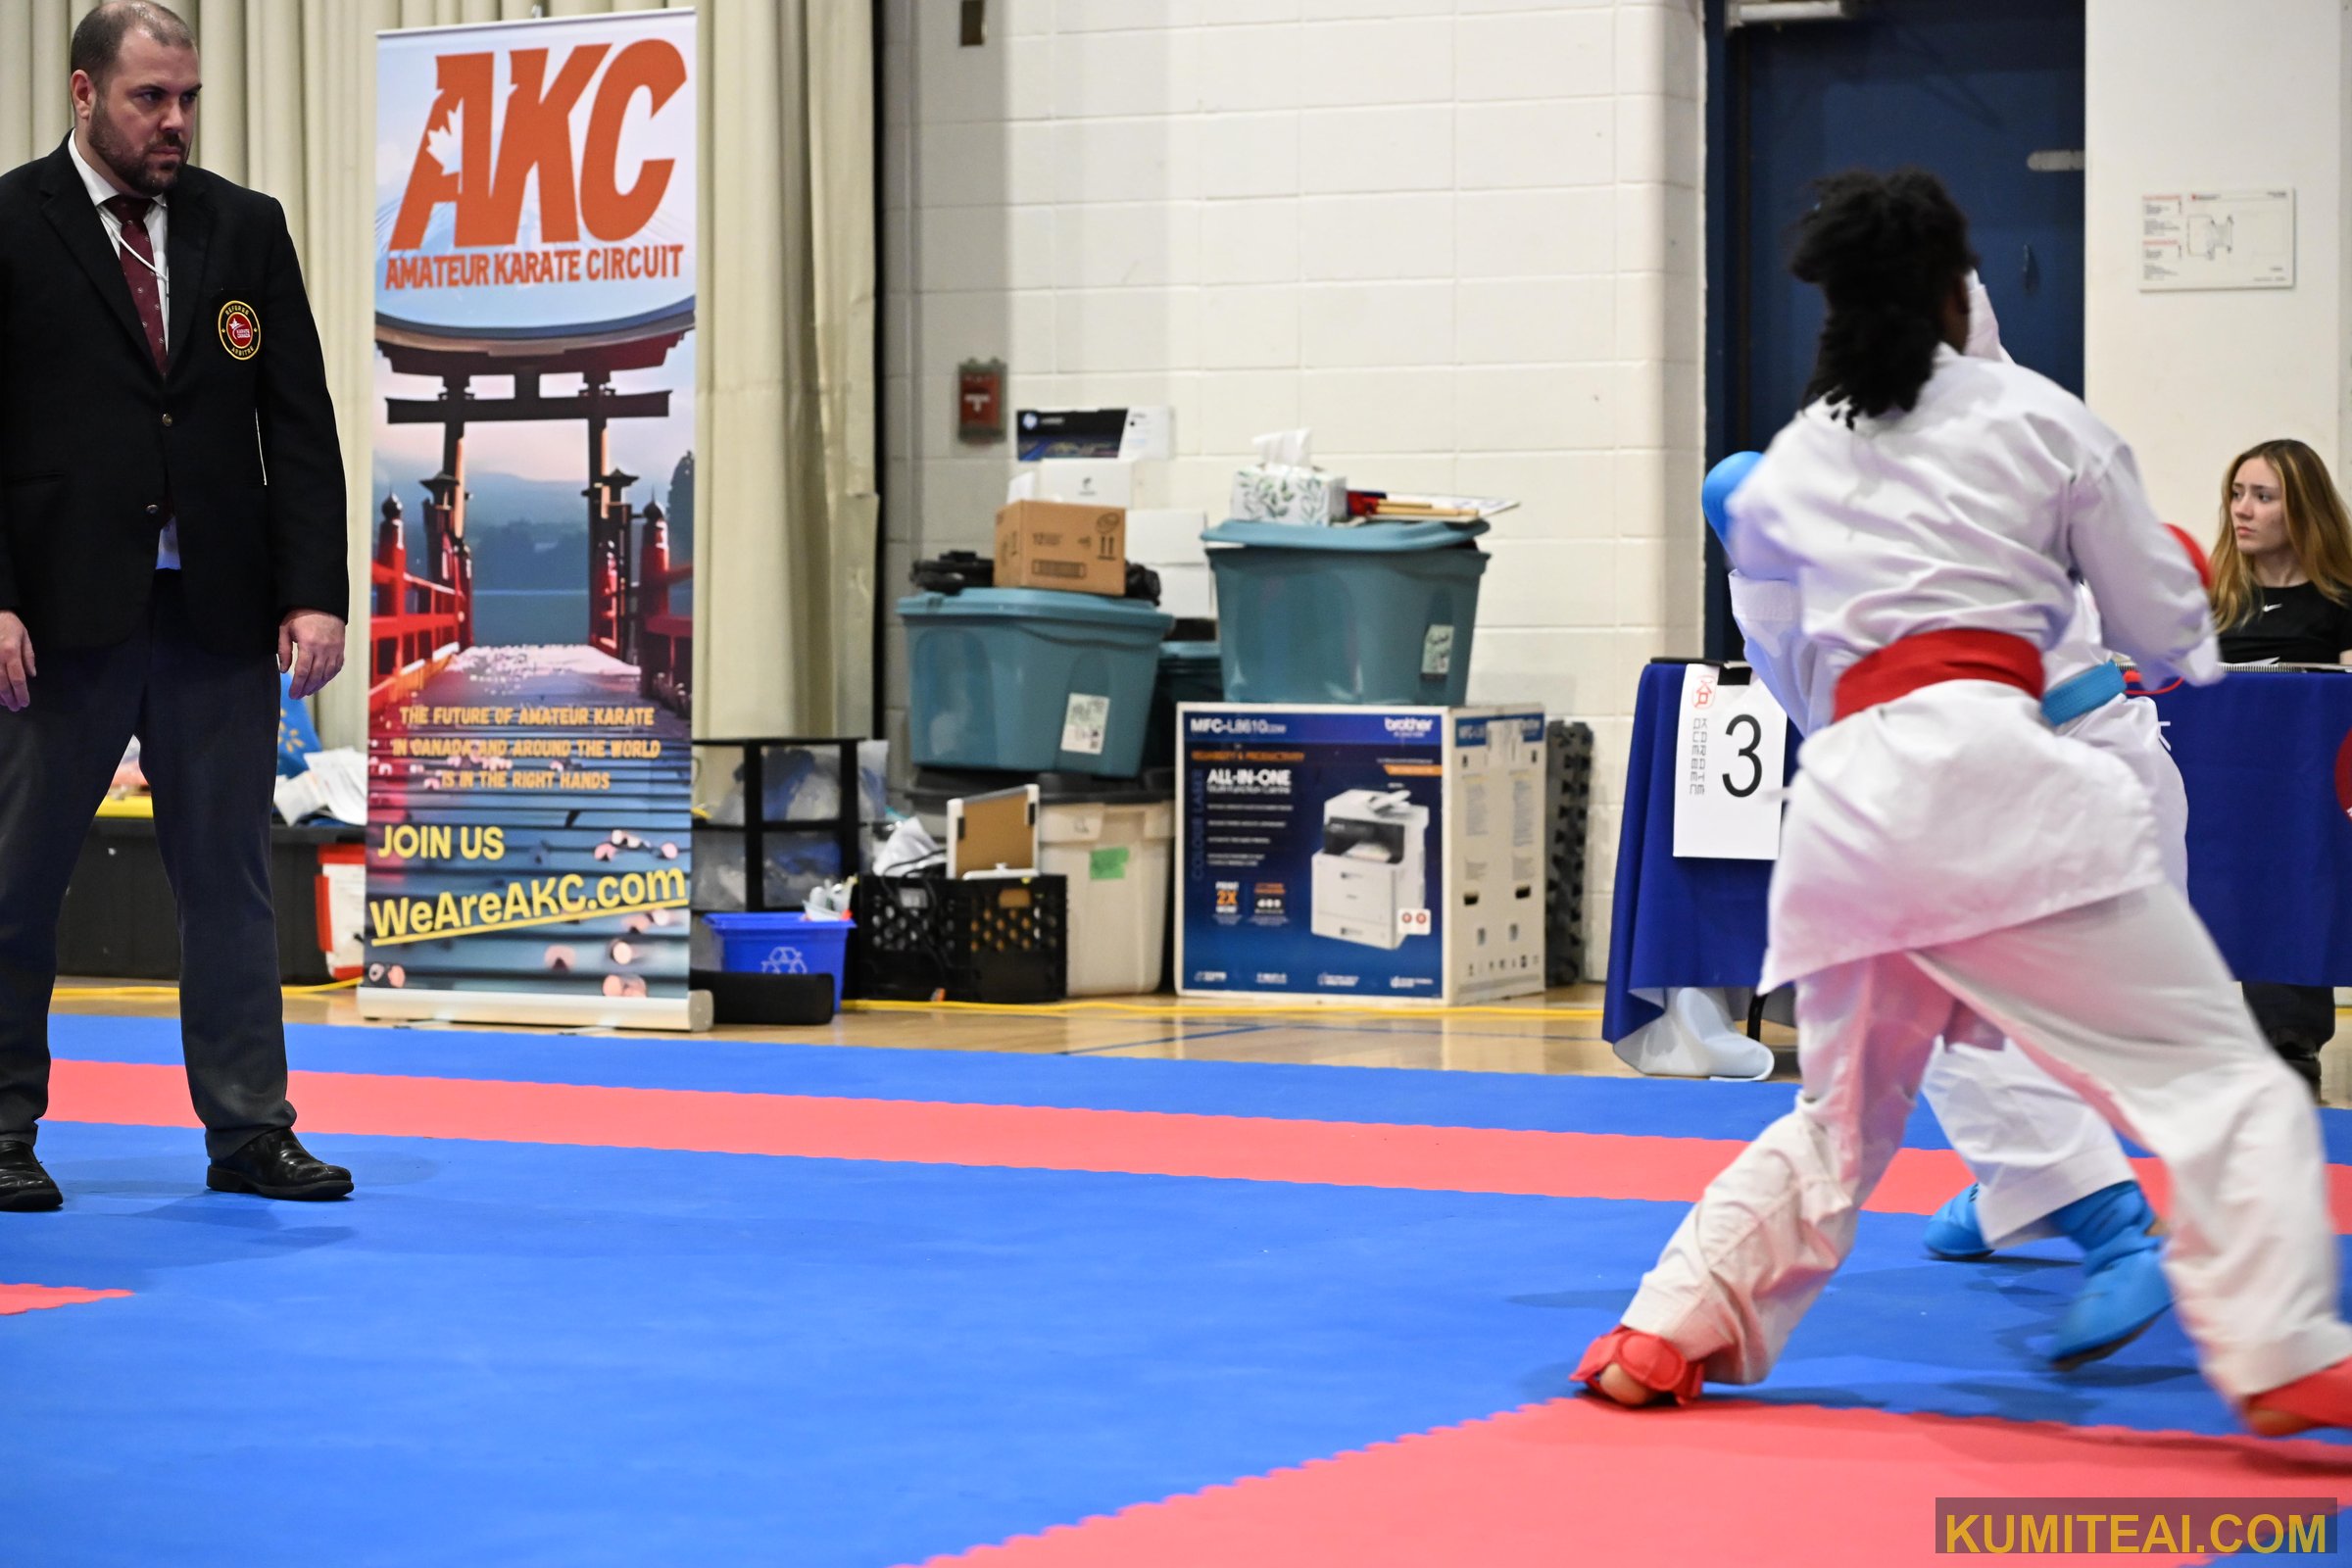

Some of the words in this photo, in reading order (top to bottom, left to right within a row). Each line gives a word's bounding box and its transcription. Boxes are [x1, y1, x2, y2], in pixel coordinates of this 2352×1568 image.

[388, 38, 687, 251] AKC
[384, 253, 489, 290] AMATEUR
[494, 250, 581, 285] KARATE
[587, 244, 684, 281] CIRCUIT
[400, 707, 428, 725] THE
[433, 707, 490, 725] FUTURE
[494, 707, 514, 725] OF
[518, 707, 589, 725] AMATEUR
[593, 707, 656, 725] KARATE
[1384, 717, 1433, 731] brother
[392, 740, 407, 757] IN
[411, 739, 471, 757] CANADA
[478, 740, 508, 757] AND
[513, 740, 572, 758] AROUND
[576, 740, 606, 758] THE
[610, 740, 662, 759] WORLD
[1722, 713, 1762, 798] 3
[442, 771, 455, 788] IS
[460, 771, 474, 788] IN
[480, 771, 507, 789] THE
[513, 771, 555, 789] RIGHT
[560, 772, 611, 790] HANDS
[1206, 768, 1292, 786] ALL-IN-ONE
[378, 825, 451, 859] JOIN
[461, 827, 506, 860] US
[369, 866, 687, 940] WeAreAKC.com
